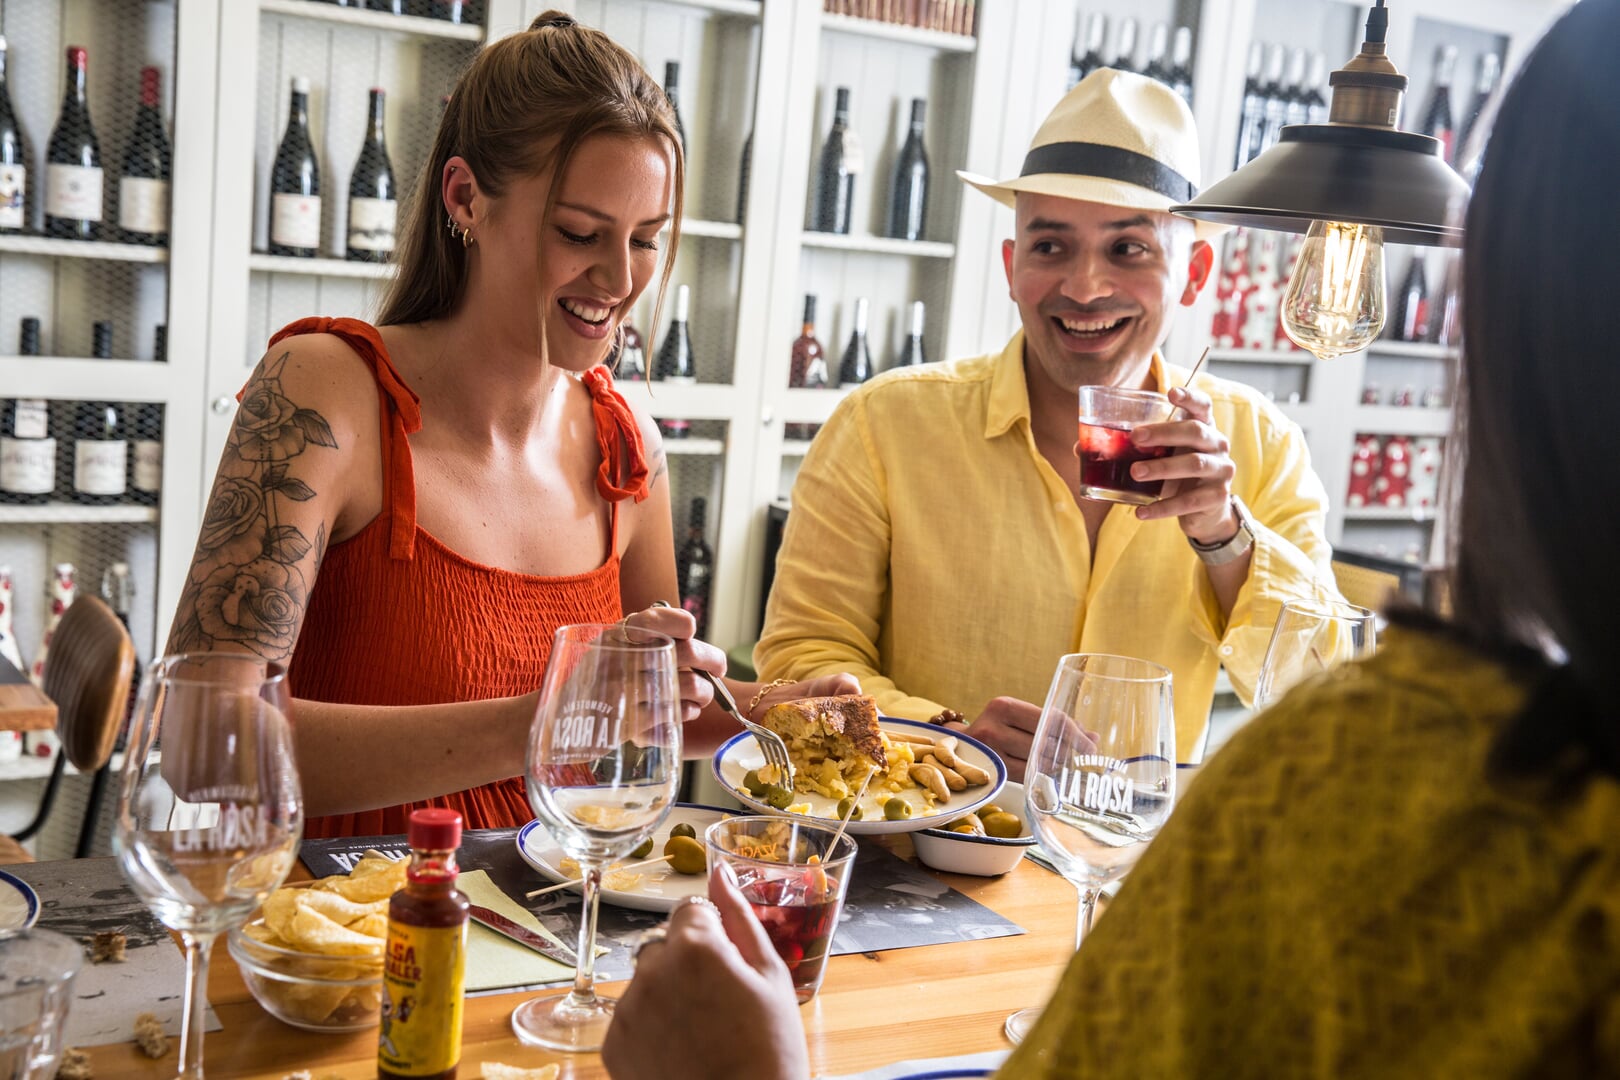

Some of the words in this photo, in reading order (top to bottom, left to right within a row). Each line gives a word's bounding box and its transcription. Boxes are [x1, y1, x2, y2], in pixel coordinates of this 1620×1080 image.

[1059, 766, 1081, 806] LA
[1084, 771, 1134, 813] ROSA
[173, 808, 202, 852] LA
